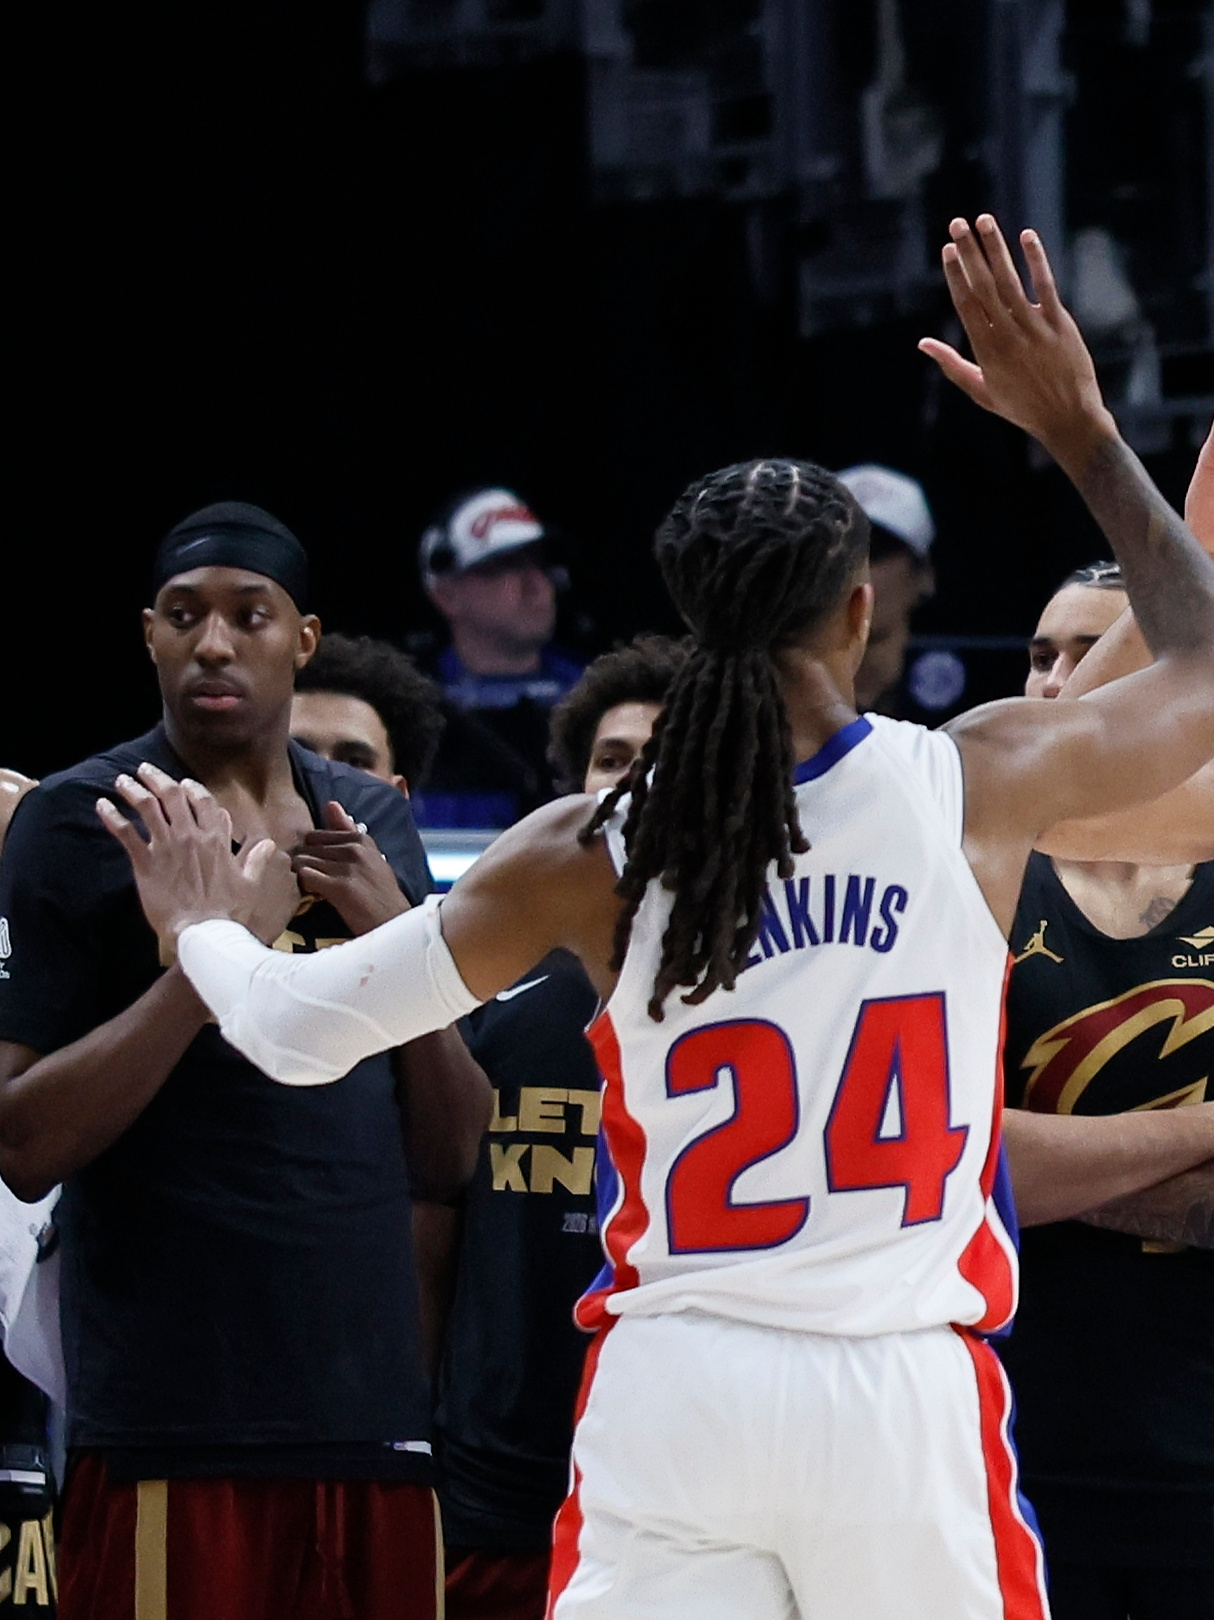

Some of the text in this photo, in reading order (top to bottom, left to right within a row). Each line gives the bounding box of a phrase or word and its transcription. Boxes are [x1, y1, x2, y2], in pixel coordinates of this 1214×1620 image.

[736, 874, 908, 972] NKINS
[489, 1087, 601, 1135] LET
[664, 990, 970, 1255] 24
